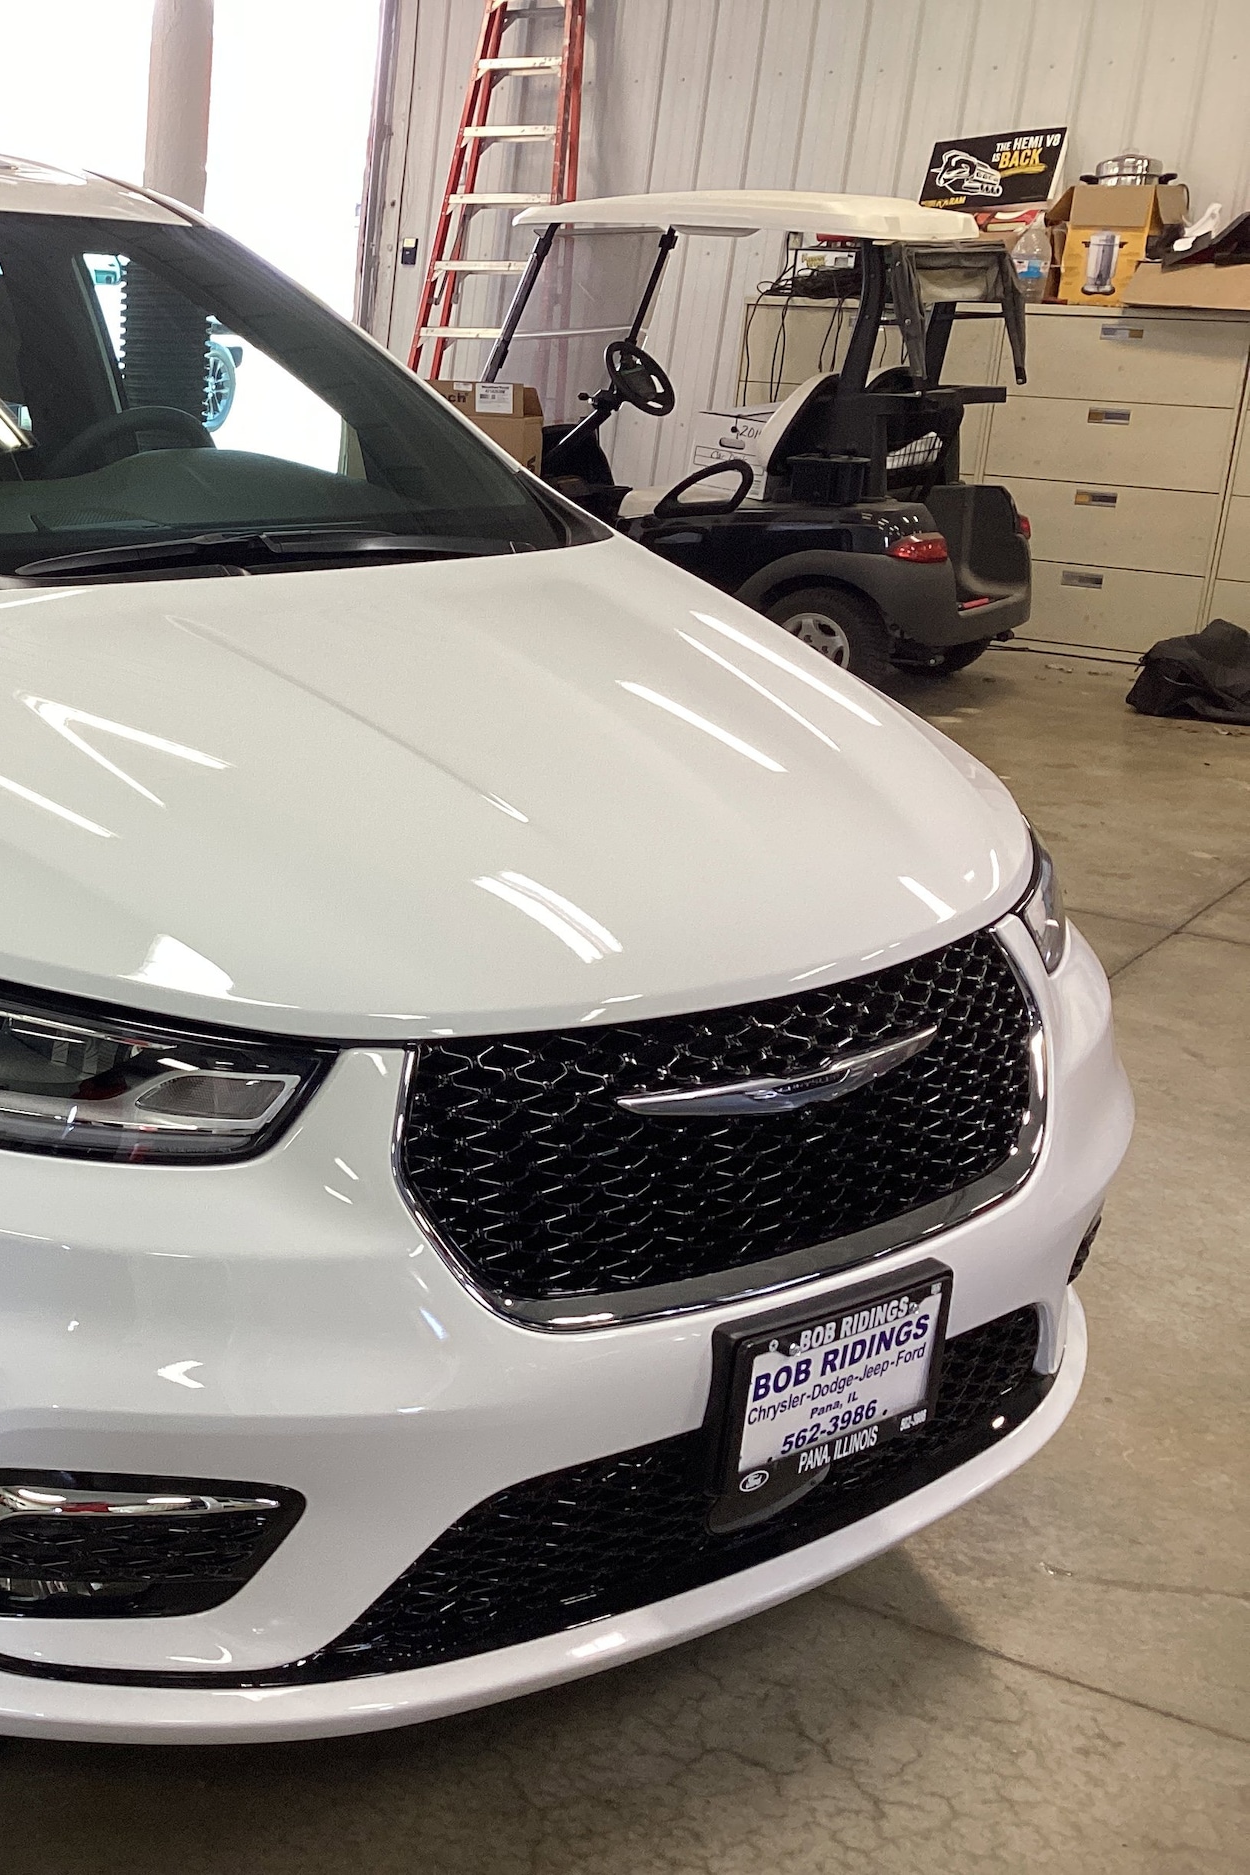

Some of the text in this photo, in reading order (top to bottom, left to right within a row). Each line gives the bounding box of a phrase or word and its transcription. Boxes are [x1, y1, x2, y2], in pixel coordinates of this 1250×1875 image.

[991, 147, 1043, 169] IS BACK
[996, 133, 1061, 152] THE HEMI V8
[800, 1296, 910, 1350] BOB RIDINGS
[752, 1314, 930, 1402] BOB RIDINGS
[747, 1342, 926, 1425] Chrysler-Dodge-Jeep-Ford
[810, 1391, 858, 1419] Pana, IL
[780, 1399, 877, 1455] 562-3986
[833, 1425, 878, 1460] ILLINOIS
